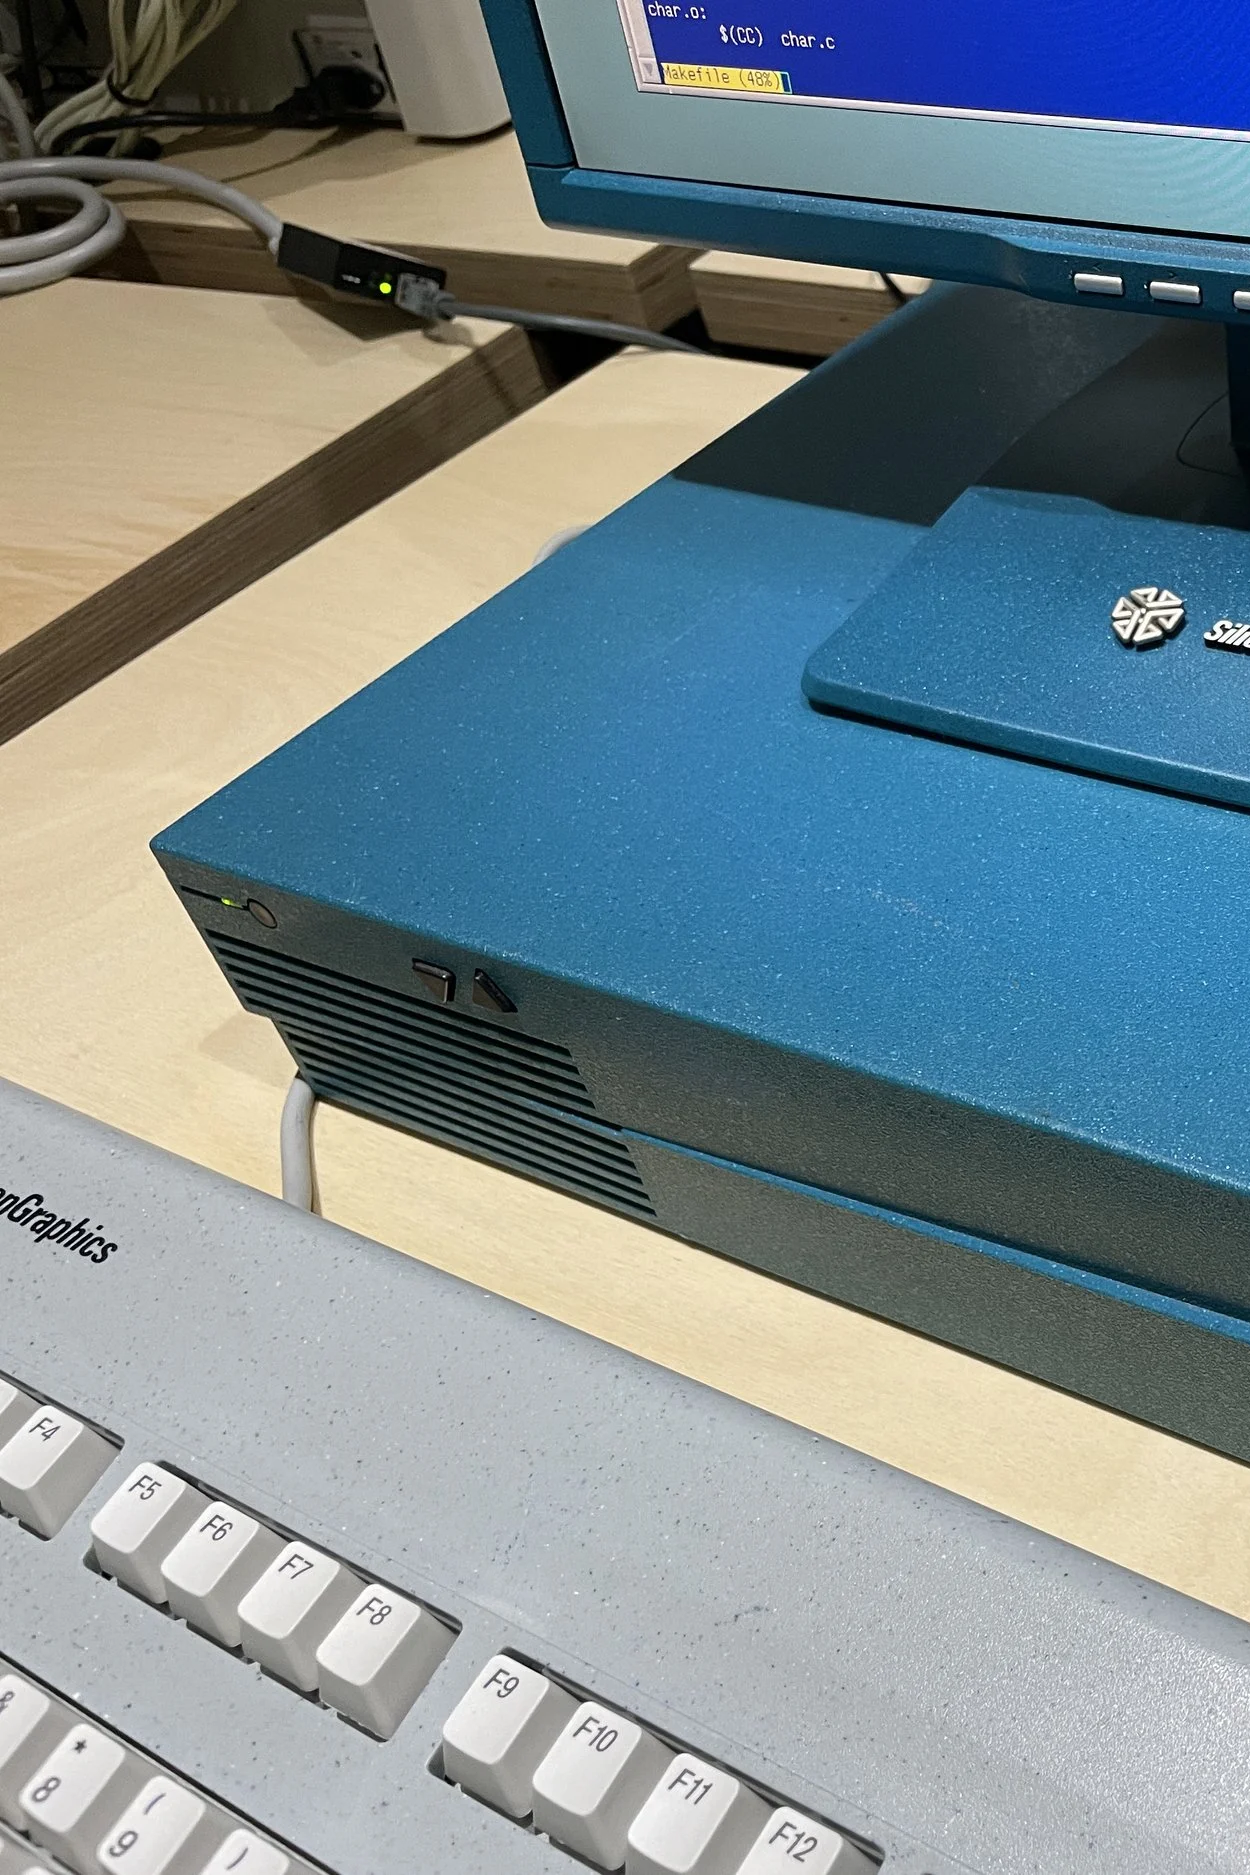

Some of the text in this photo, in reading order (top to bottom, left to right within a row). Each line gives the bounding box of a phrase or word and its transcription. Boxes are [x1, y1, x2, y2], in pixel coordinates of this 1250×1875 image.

[648, 1, 706, 20] char.o:
[719, 24, 836, 50] $(CC) char.c
[663, 64, 781, 91] Makefile (48%)
[28, 1417, 61, 1442] F4
[128, 1474, 162, 1501] F5
[199, 1514, 234, 1542] F6
[278, 1553, 314, 1580] F7
[356, 1597, 392, 1626] F8
[483, 1669, 519, 1699] F9
[572, 1716, 618, 1752] F10
[31, 1776, 61, 1803] 8
[668, 1768, 714, 1805] F11
[109, 1830, 138, 1857] 9
[768, 1821, 818, 1862] F12
